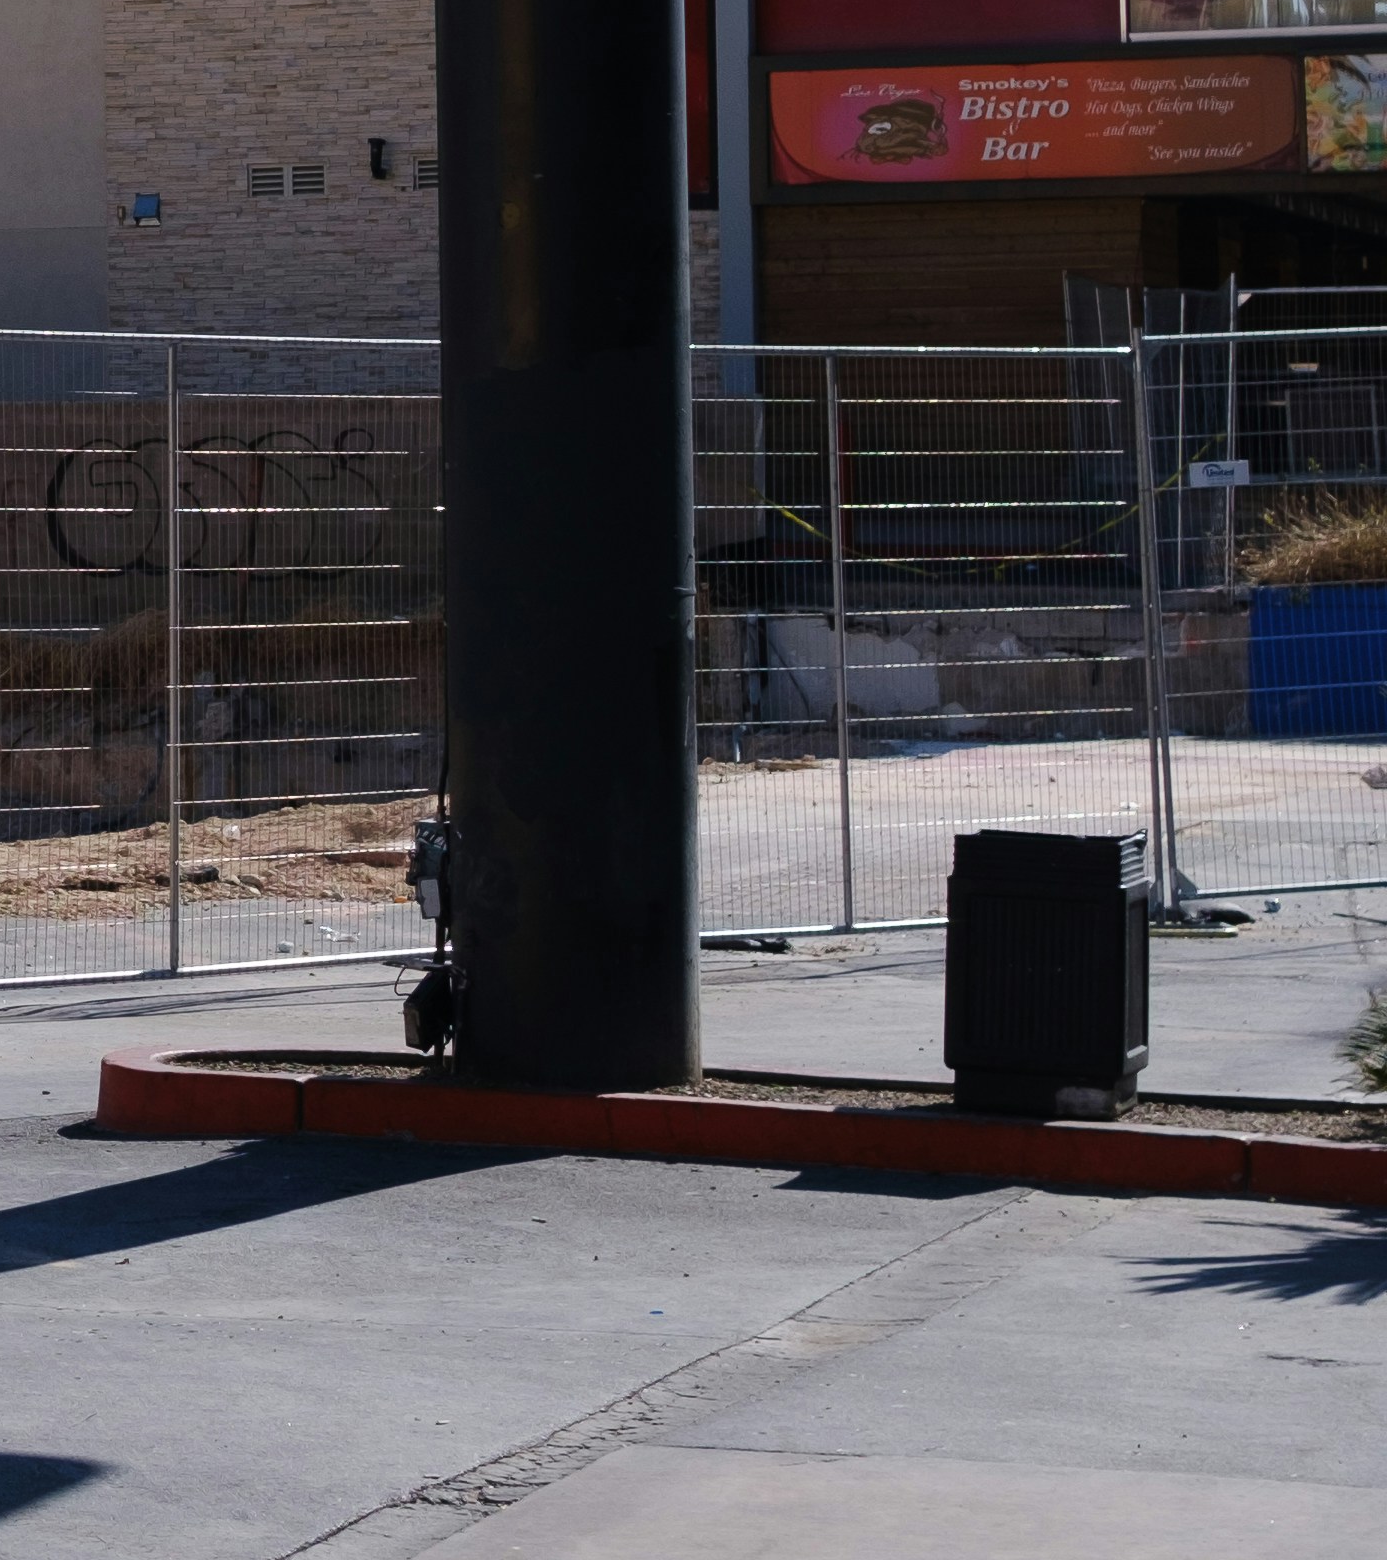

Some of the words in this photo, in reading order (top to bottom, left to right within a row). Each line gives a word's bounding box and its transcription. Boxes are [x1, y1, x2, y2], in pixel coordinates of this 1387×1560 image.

[958, 76, 1069, 92] Smokey's
[1180, 72, 1251, 90] Sandwiches
[959, 95, 1070, 120] Bistro
[1084, 100, 1109, 115] Hot
[1147, 96, 1193, 115] Chicken
[1196, 95, 1235, 116] Wings
[1102, 121, 1129, 137] and
[981, 136, 1050, 161] Bar
[1173, 149, 1201, 163] you
